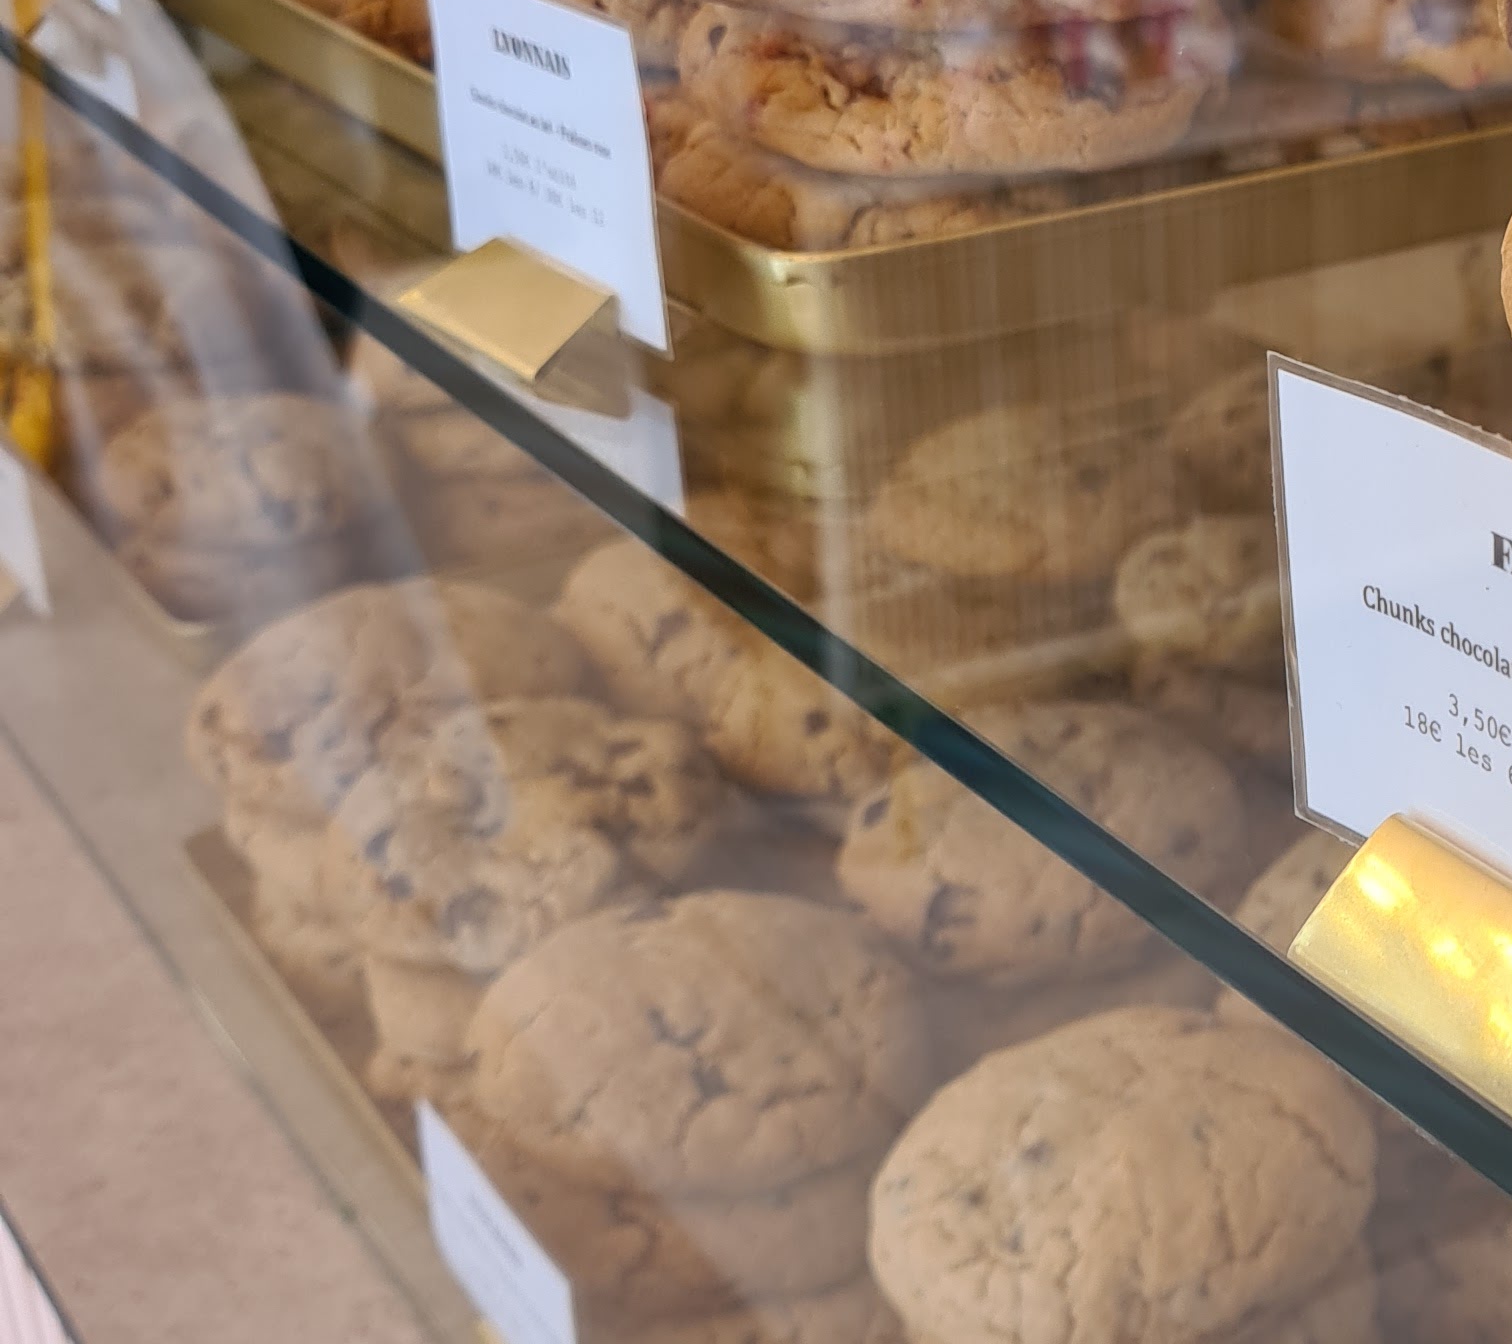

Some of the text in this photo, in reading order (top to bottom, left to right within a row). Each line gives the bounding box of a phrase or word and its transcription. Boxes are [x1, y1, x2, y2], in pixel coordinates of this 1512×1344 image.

[490, 27, 571, 80] LYONNAIS
[1362, 584, 1436, 637] Chunks
[1404, 704, 1443, 743] 18€
[1455, 732, 1493, 773] les
[1448, 692, 1512, 748] 3,50€
